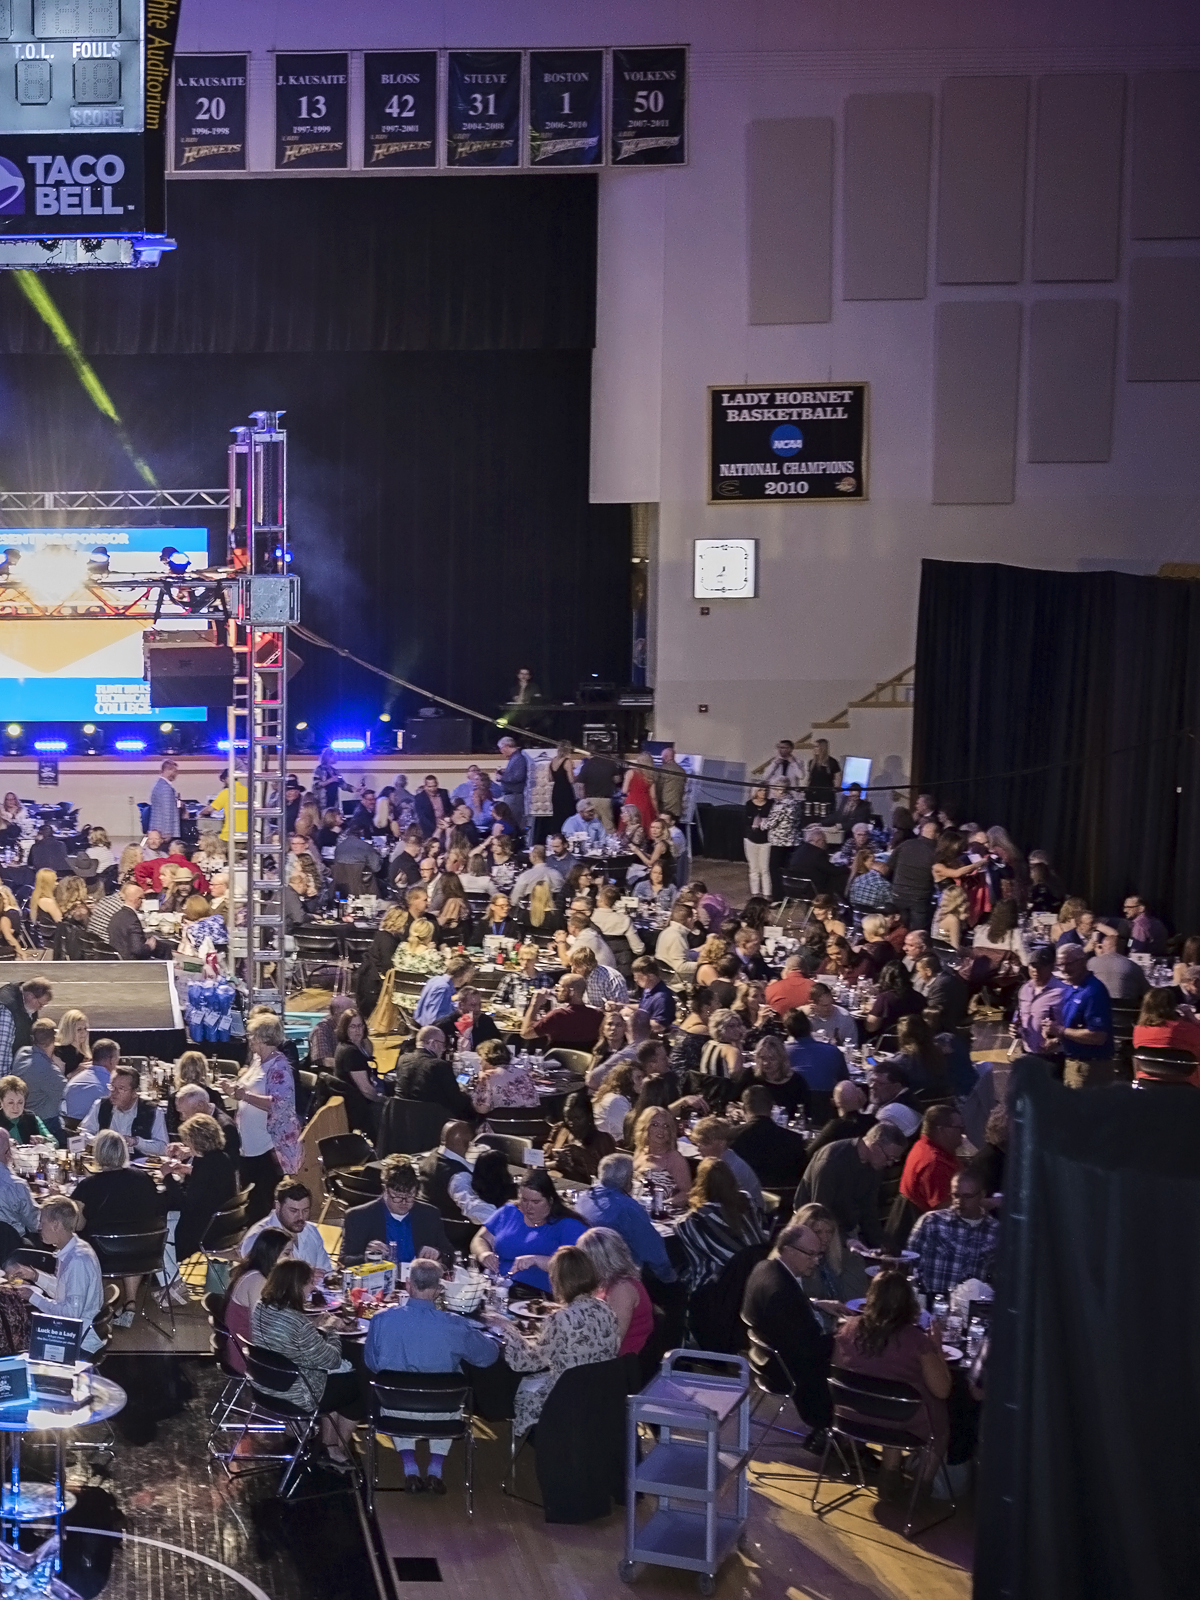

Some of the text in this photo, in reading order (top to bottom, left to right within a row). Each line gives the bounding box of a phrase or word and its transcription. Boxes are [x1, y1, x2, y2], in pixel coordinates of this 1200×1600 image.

[13, 43, 54, 59] T.O.L.
[72, 42, 121, 58] FOULS
[146, 0, 177, 129] hite Auditorium
[176, 77, 246, 87] A. KAUSAITE
[277, 75, 347, 86] J. KAUSAITE
[381, 74, 421, 84] BLOSS
[463, 74, 508, 84] STUEVE
[543, 73, 590, 83] BOSTON
[623, 71, 677, 81] VOLKENS
[195, 97, 226, 120] 20
[298, 95, 327, 119] 13
[384, 95, 417, 118] 42
[468, 93, 498, 116] 31
[560, 92, 573, 114] 1
[633, 91, 664, 113] 50
[73, 109, 121, 126] SCORE
[180, 144, 243, 167] HORNETS
[281, 142, 344, 165] HORNETS
[370, 140, 433, 163] HORNETS
[454, 139, 515, 160] HORNETS
[27, 154, 125, 184] TACO
[35, 186, 124, 215] BELL
[721, 391, 853, 406] LADY HORNET
[726, 407, 848, 422] BASKETBALL
[772, 439, 803, 449] NCAA
[719, 461, 855, 477] NATIONAL CHAMPIONS
[764, 481, 810, 495] 2010
[94, 703, 153, 715] COLLEGE
